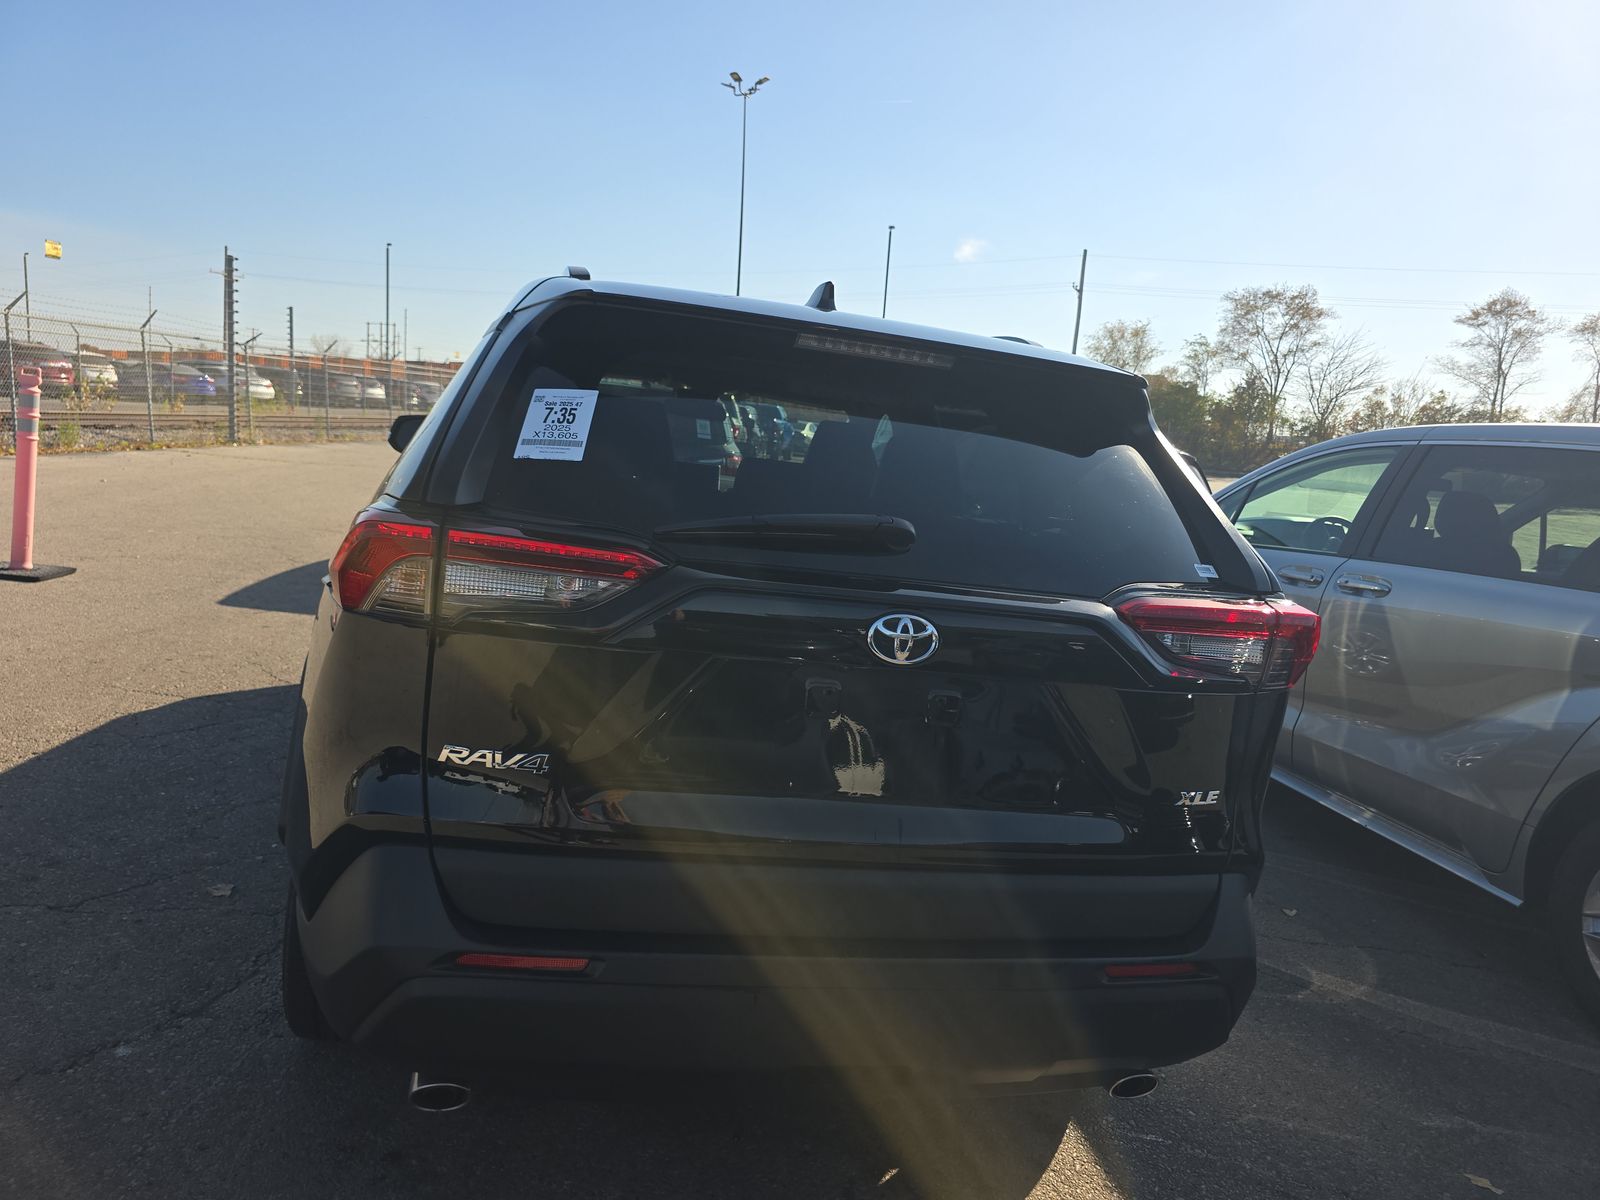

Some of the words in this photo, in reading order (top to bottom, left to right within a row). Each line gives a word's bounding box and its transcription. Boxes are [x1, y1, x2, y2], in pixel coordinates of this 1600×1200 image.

[543, 407, 578, 424] 7:35
[543, 424, 571, 432] 2025
[437, 744, 549, 774] RAV4
[1174, 790, 1220, 806] XLE
